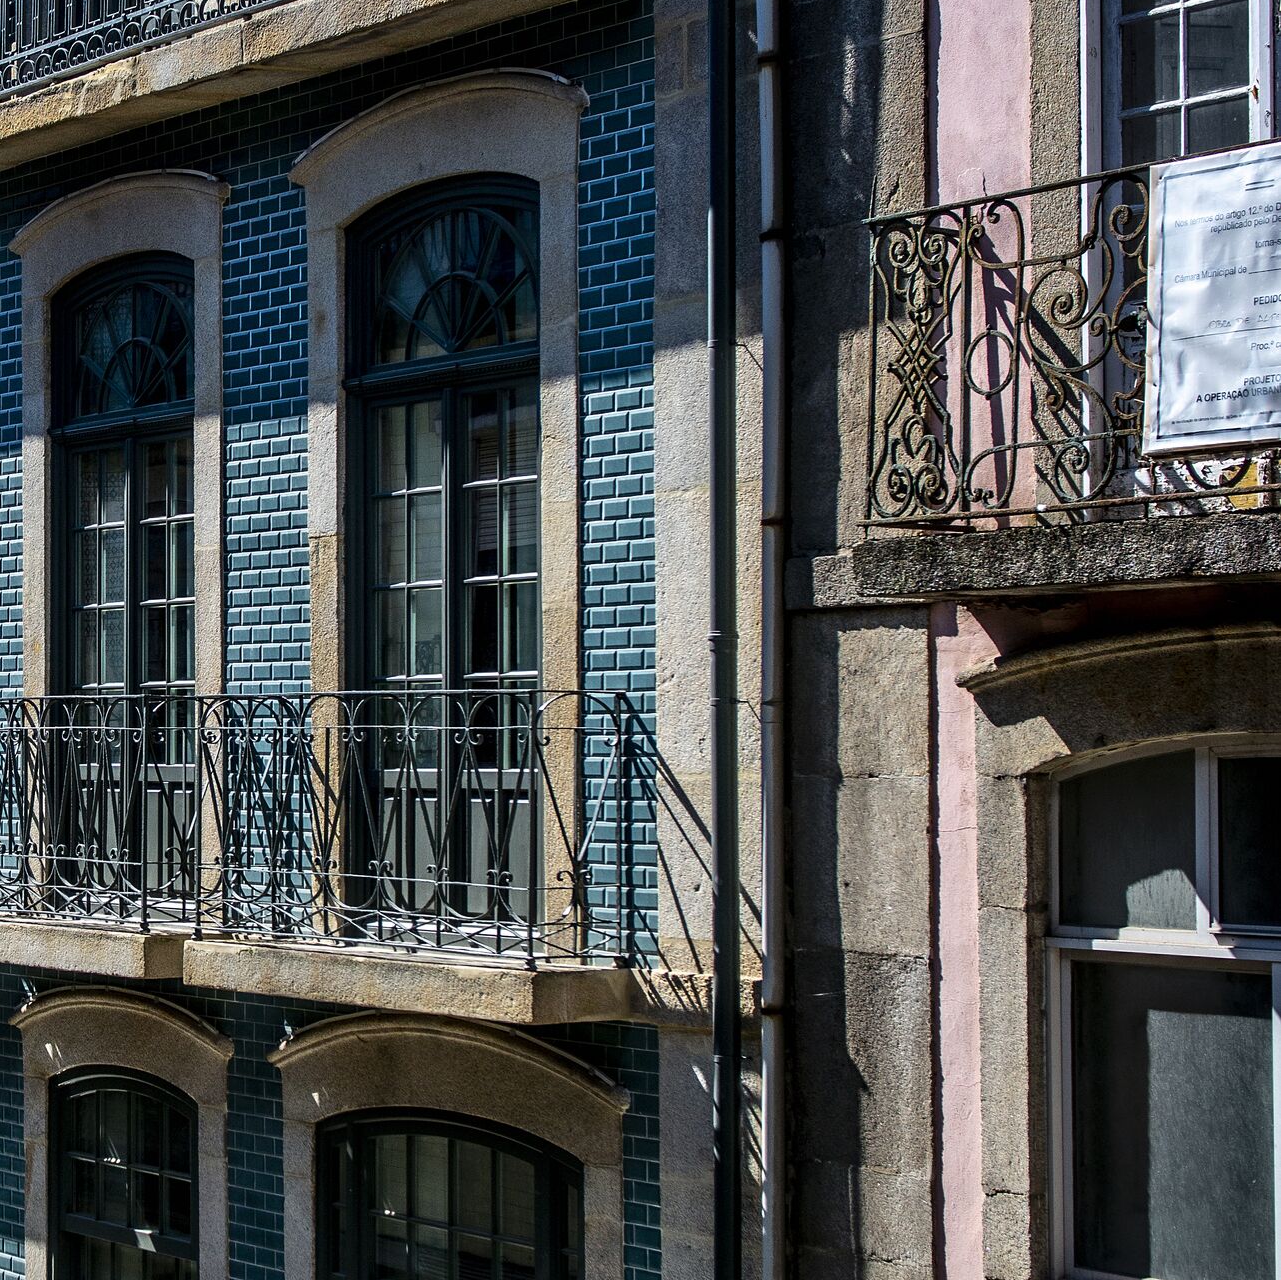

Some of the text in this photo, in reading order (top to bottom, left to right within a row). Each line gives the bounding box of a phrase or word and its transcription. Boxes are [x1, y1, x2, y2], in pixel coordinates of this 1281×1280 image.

[1214, 213, 1225, 222] do
[1226, 208, 1247, 220] artigo
[1264, 204, 1274, 213] do
[1210, 217, 1253, 234] republicado
[1254, 215, 1270, 228] pelo
[1174, 265, 1247, 284] Câmara Municipal de
[1196, 394, 1204, 403] A
[1204, 387, 1250, 402] OPERAÇÃO
